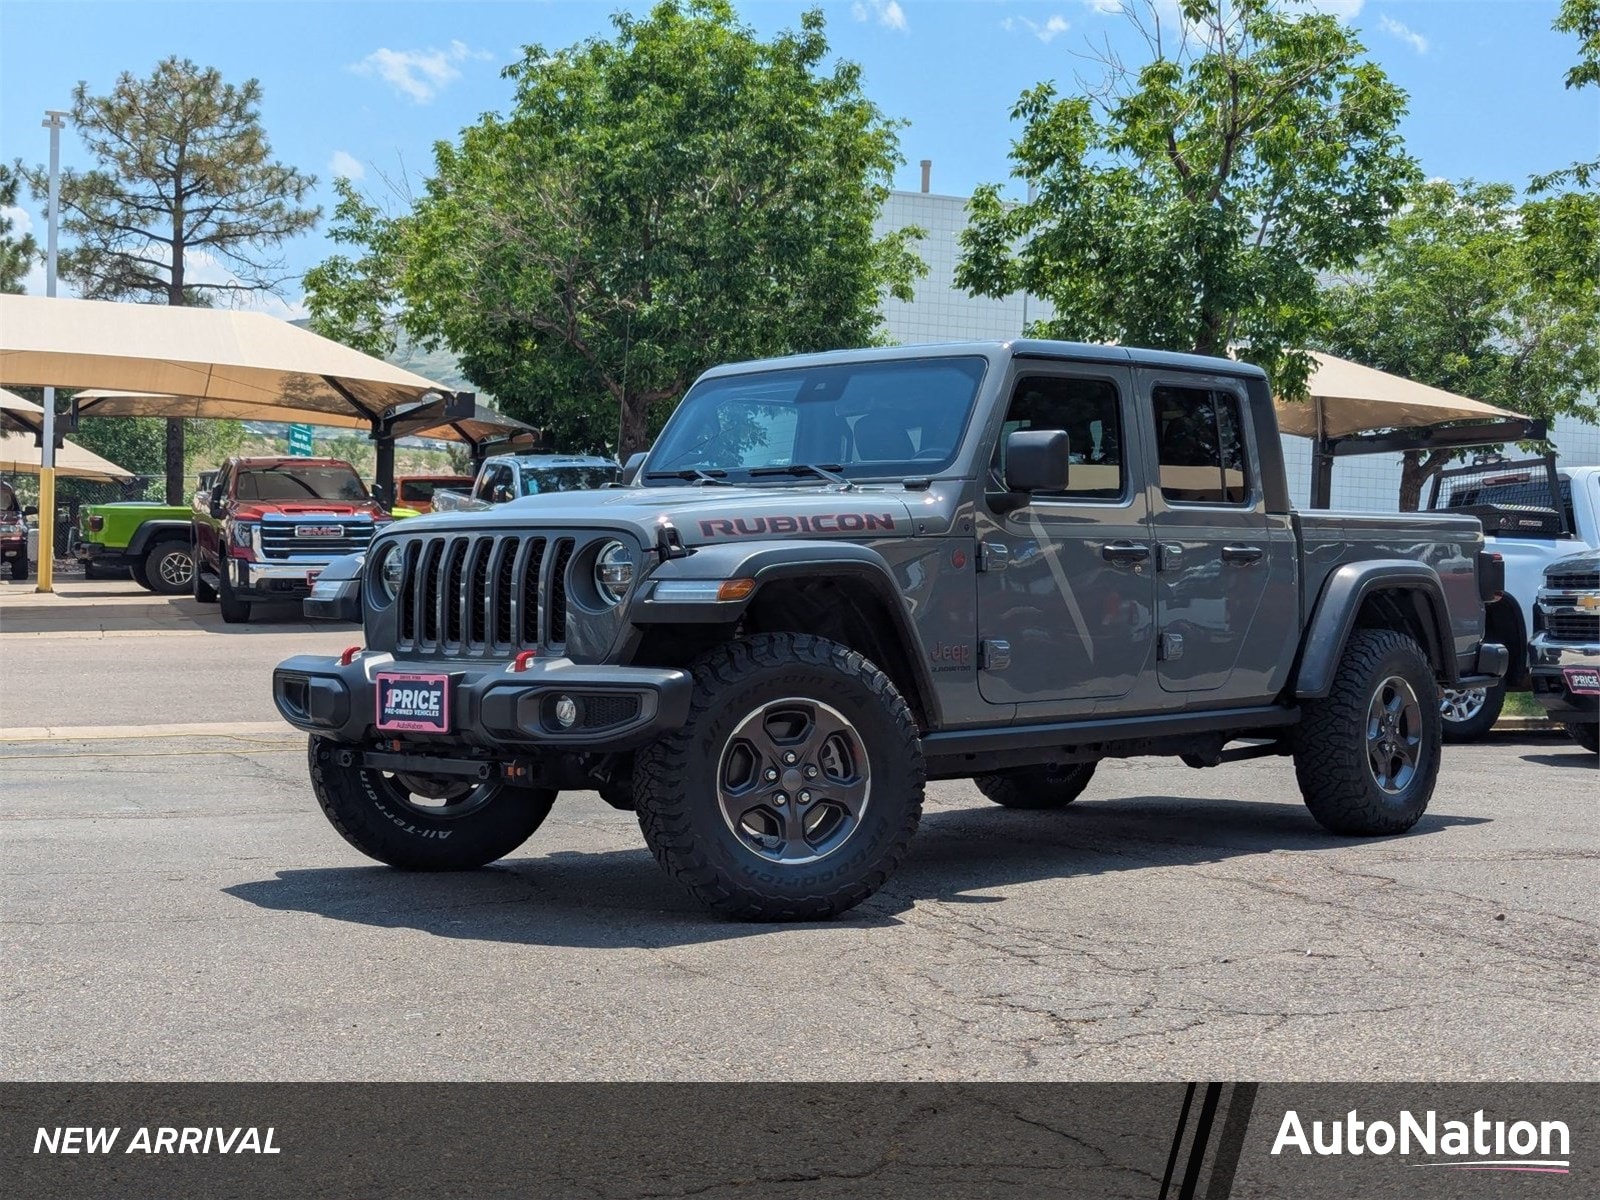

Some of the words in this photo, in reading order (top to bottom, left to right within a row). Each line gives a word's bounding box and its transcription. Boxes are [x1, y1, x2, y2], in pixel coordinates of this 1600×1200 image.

[298, 527, 341, 536] GMC
[698, 513, 896, 538] RUBICON
[929, 640, 970, 664] Jeep
[414, 708, 440, 717] VEHICLES
[359, 769, 455, 840] All-Terrain
